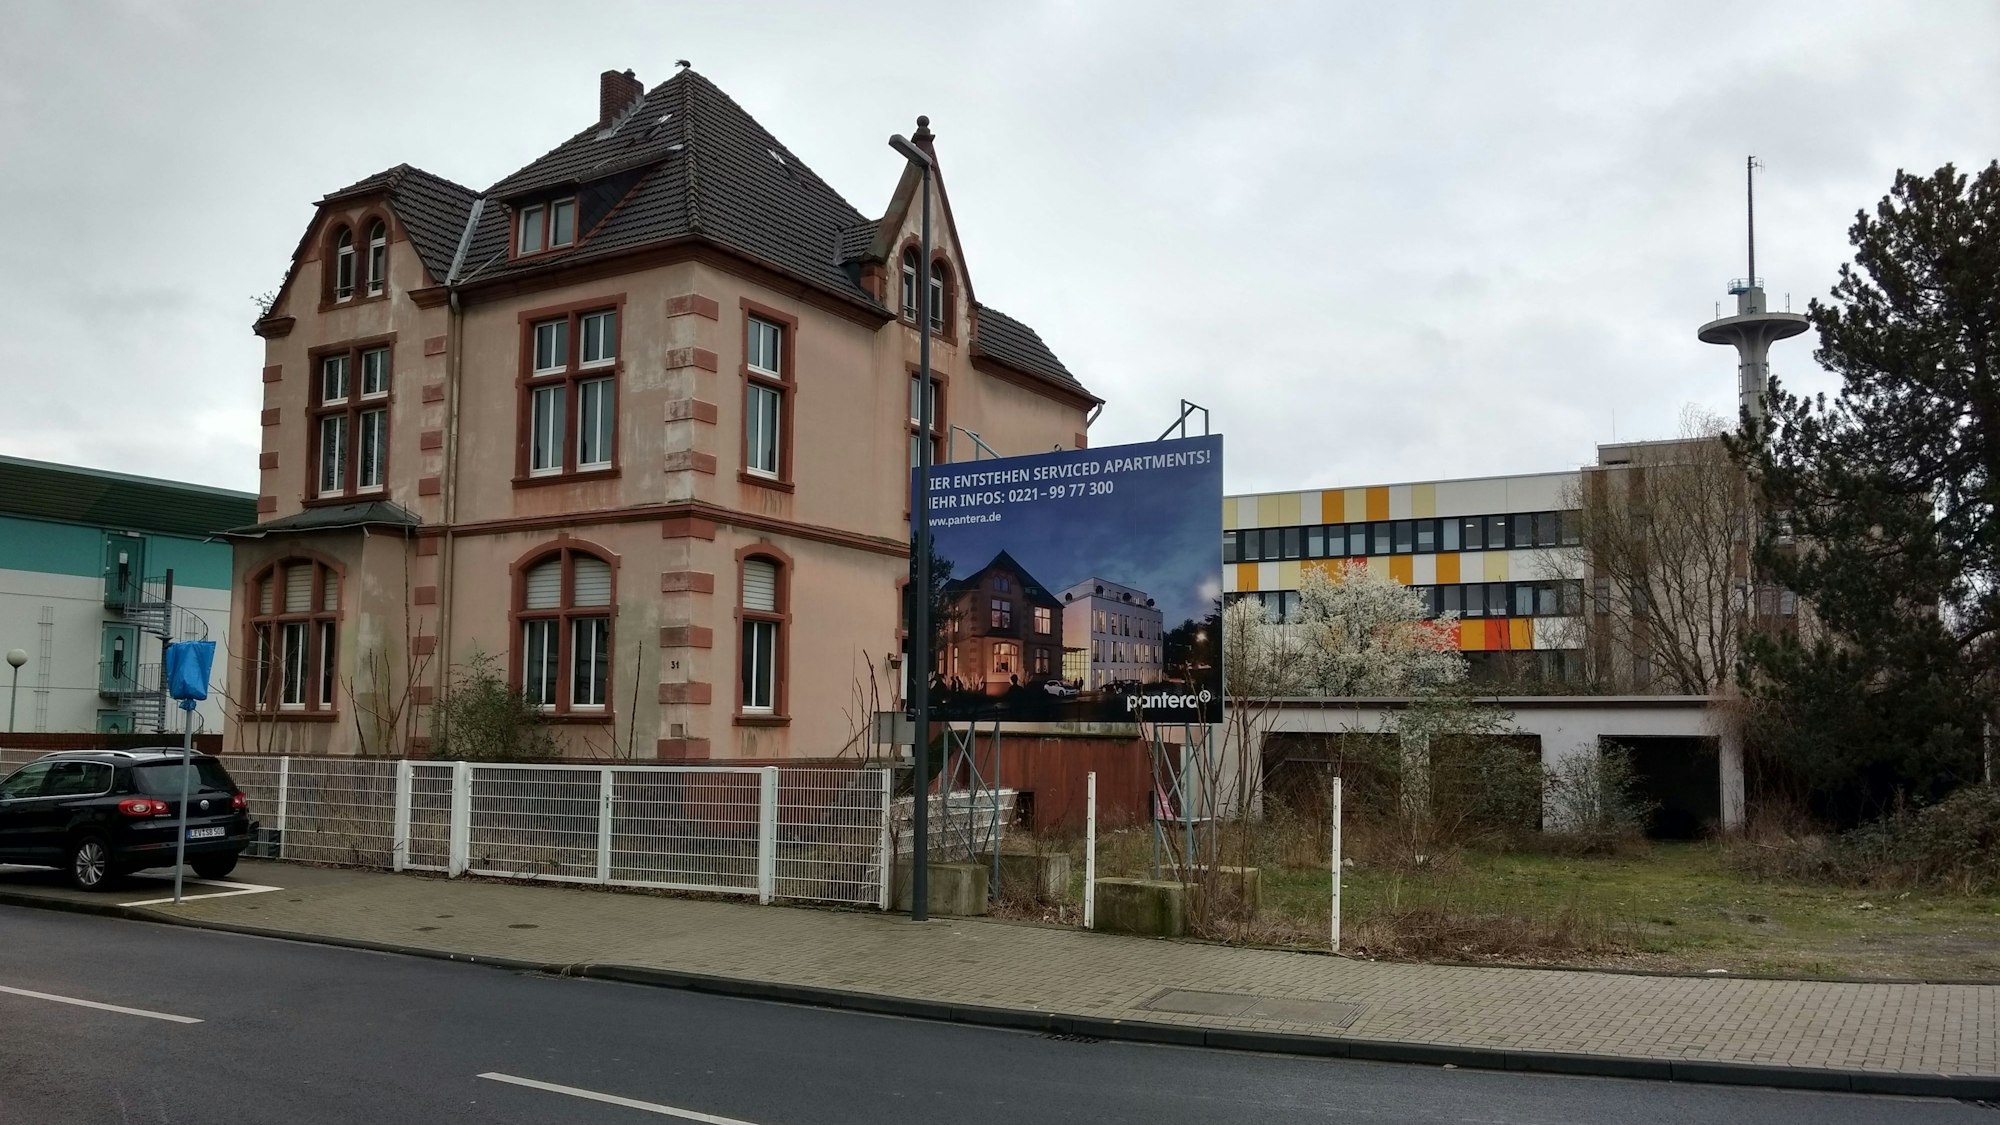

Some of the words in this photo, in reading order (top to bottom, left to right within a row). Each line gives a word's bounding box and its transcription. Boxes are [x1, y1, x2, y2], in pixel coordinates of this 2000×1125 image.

[954, 468, 1030, 489] ENTSTEHEN
[1033, 461, 1100, 480] SERVICED
[1103, 449, 1211, 474] APARTMENTS!
[928, 495, 957, 510] EHR
[960, 491, 1005, 507] INFOS:
[1069, 483, 1086, 497] 77
[1089, 480, 1114, 496] 300
[671, 660, 680, 670] 31
[1126, 692, 1199, 712] pantera
